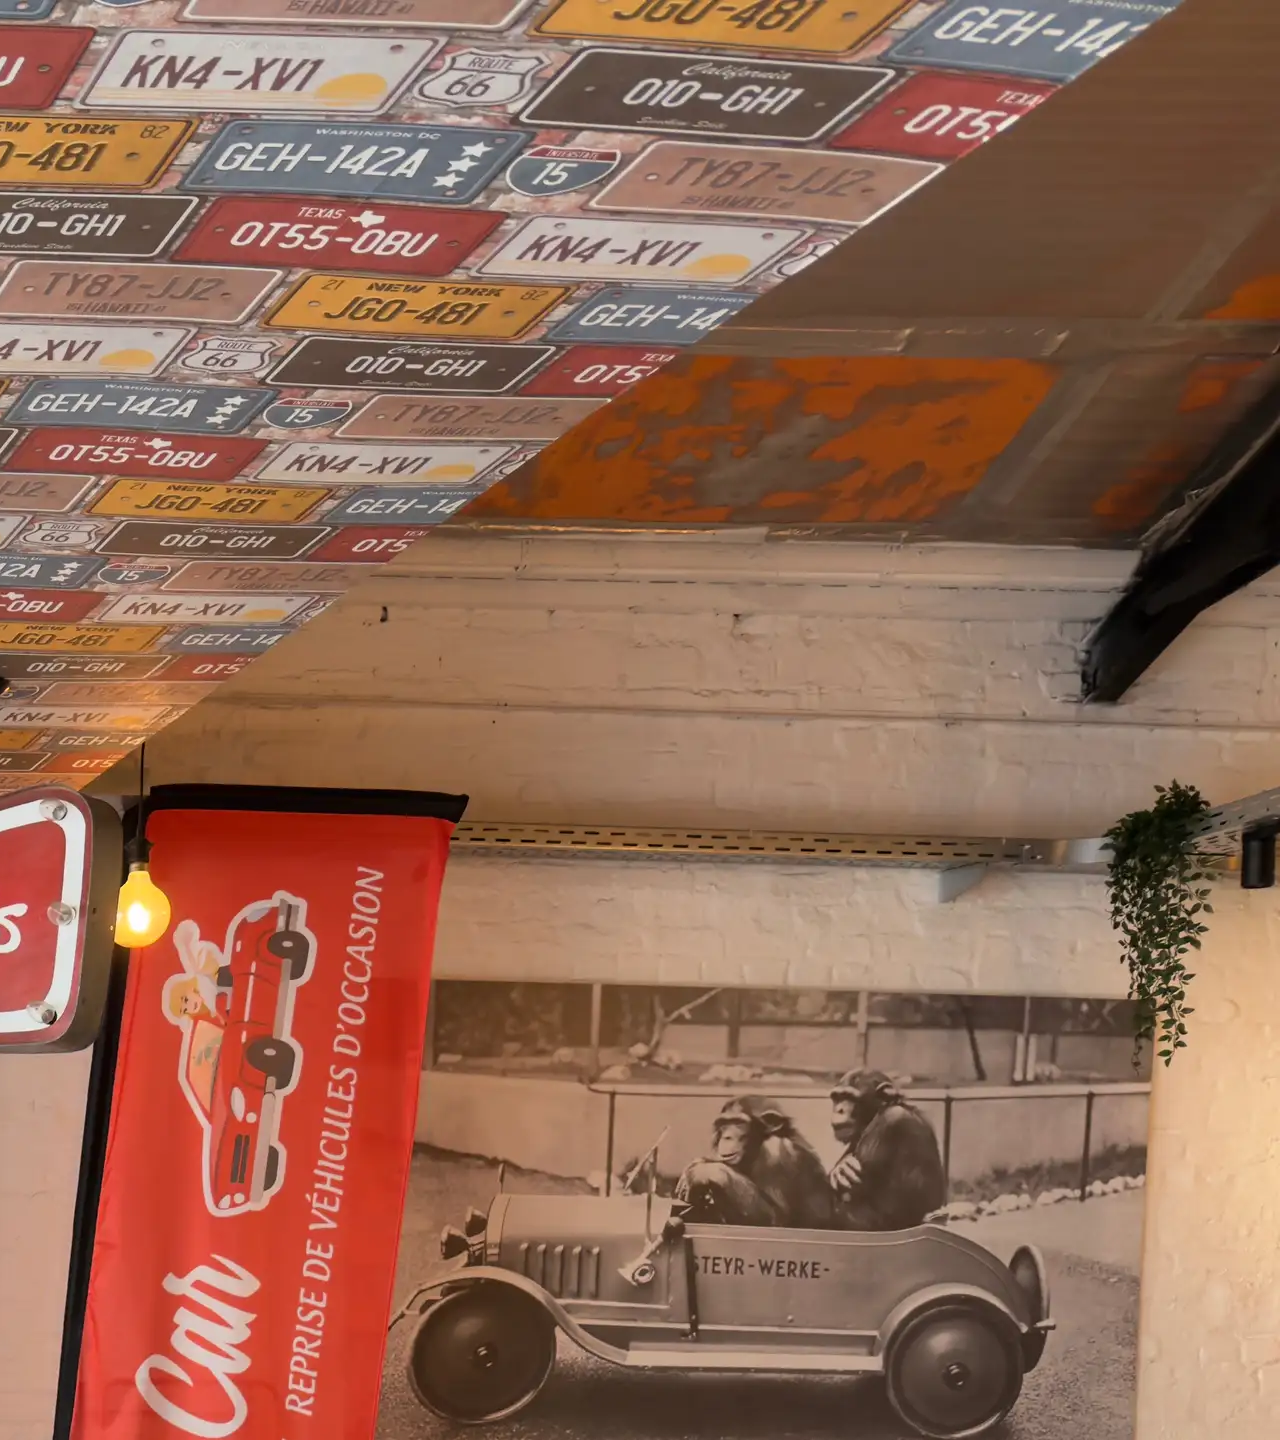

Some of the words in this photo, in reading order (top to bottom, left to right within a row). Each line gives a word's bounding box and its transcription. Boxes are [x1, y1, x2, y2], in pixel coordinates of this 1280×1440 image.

[468, 56, 518, 73] ROUTE
[683, 61, 793, 83] California
[443, 74, 495, 98] 66
[38, 121, 122, 136] YORK
[213, 142, 430, 180] GEH-142A
[525, 162, 582, 185] 15
[670, 156, 870, 194] TY87-JJ2
[293, 208, 348, 219] TEXAS
[333, 865, 385, 1058] D'OCCASION
[305, 1060, 359, 1231] VÉHICULES
[303, 1239, 334, 1282] DE
[134, 1253, 262, 1440] Car
[285, 1287, 328, 1417] REPRISE
